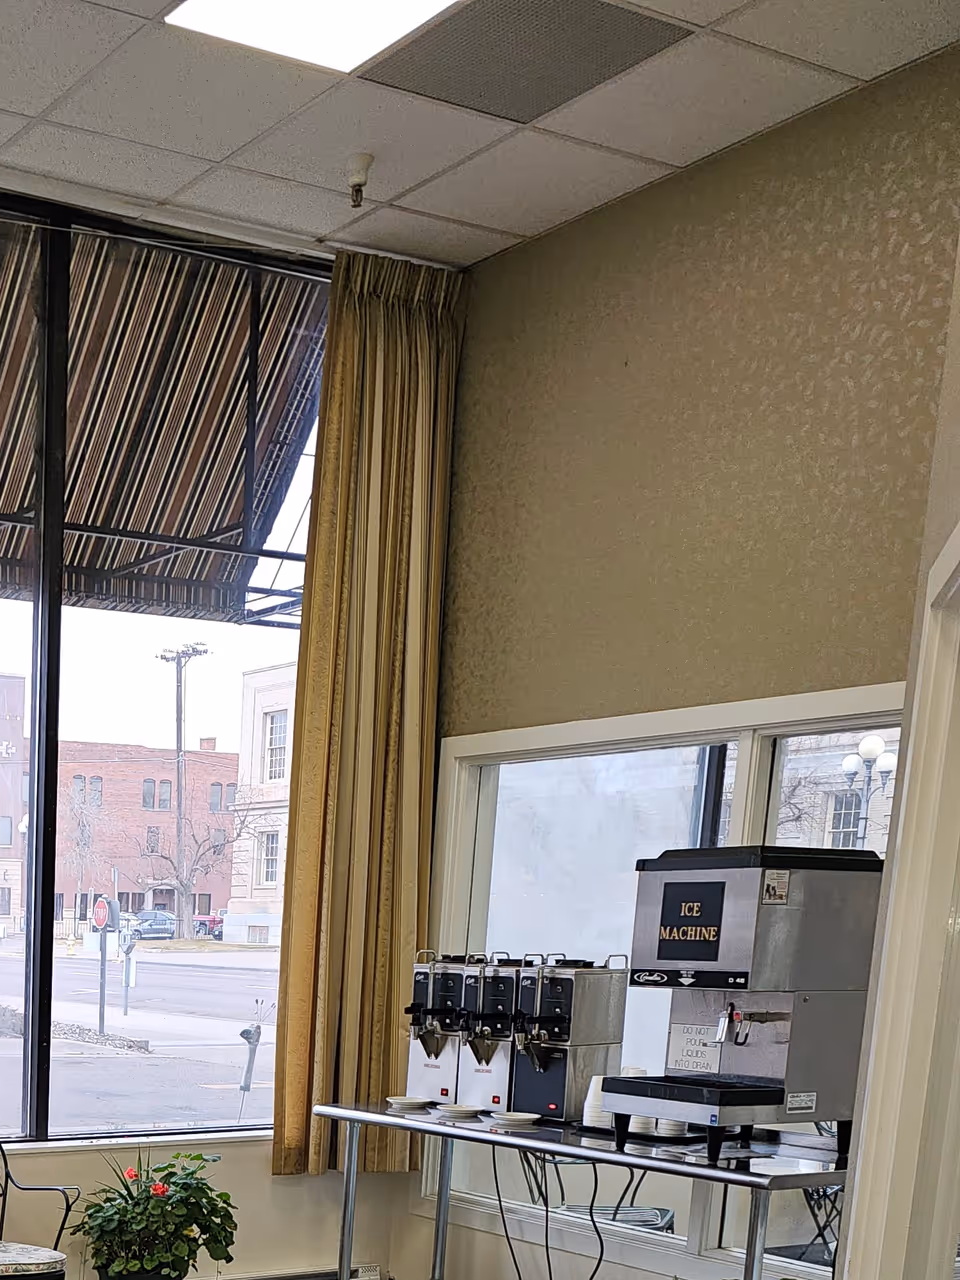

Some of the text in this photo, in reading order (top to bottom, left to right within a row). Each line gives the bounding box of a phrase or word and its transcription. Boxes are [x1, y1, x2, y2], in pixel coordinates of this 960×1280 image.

[680, 902, 701, 916] ICE
[660, 926, 718, 940] MACHINE
[683, 1026, 710, 1036] DO NOT
[682, 1049, 707, 1058] LIQUIDS
[675, 1060, 712, 1070] INTO DRAIN
